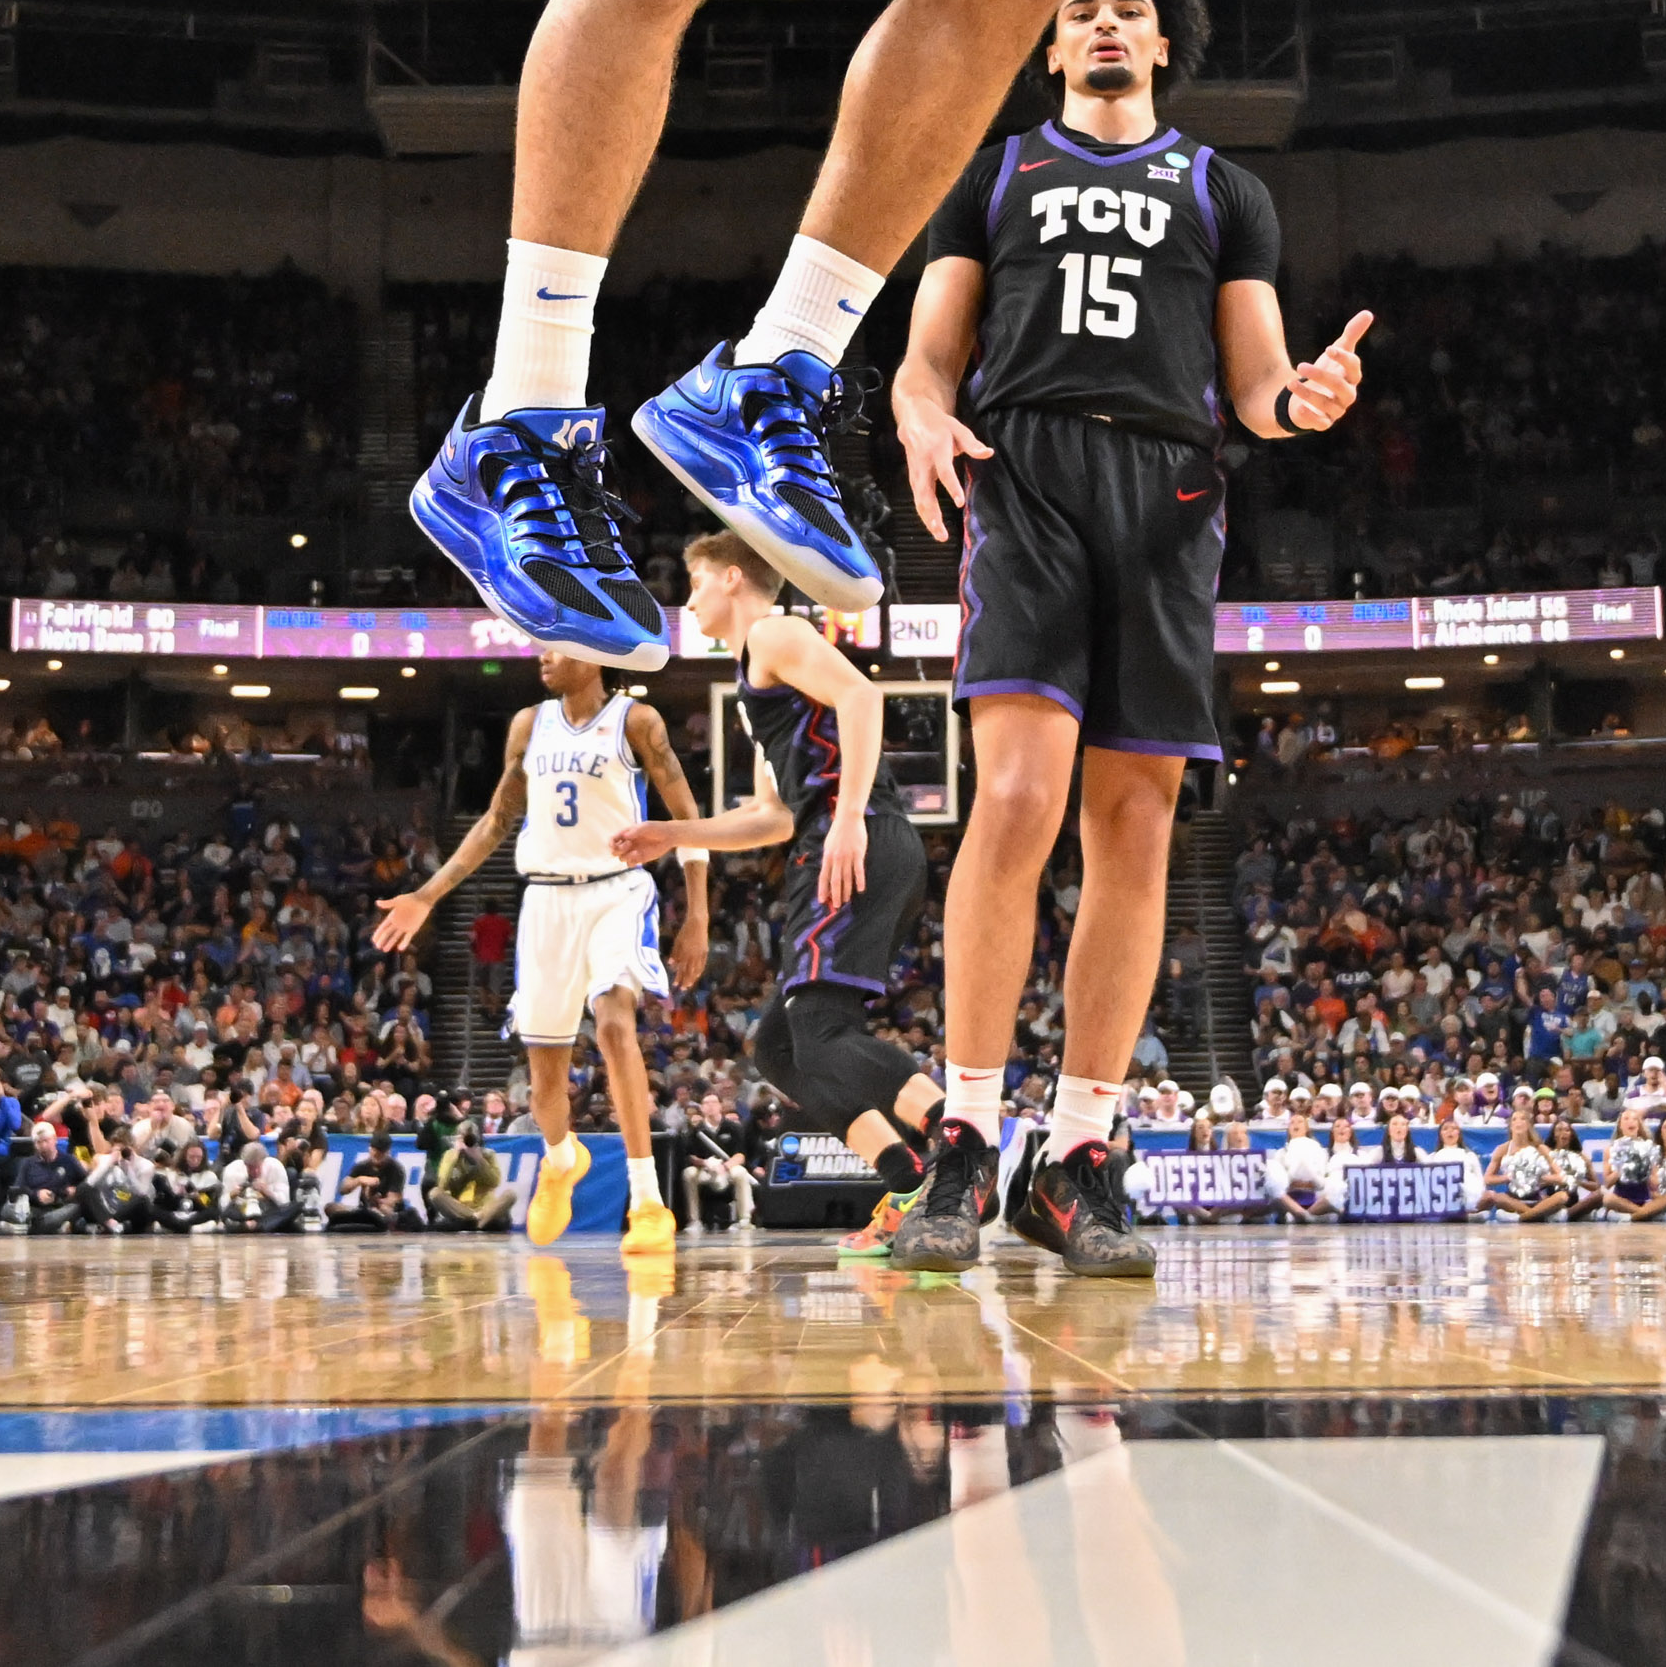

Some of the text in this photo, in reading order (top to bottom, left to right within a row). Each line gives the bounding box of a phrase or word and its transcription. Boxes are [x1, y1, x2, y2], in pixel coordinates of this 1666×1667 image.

[1031, 186, 1172, 248] TCU
[1057, 252, 1143, 339] 15
[40, 601, 134, 628] Fairfield
[1433, 598, 1484, 623] Rhode
[1486, 595, 1537, 621] Island
[1593, 603, 1633, 622] Final
[39, 625, 90, 651] Notre
[93, 626, 144, 653] Dame
[198, 618, 239, 638] Final
[1247, 625, 1323, 651] 2 0
[1434, 621, 1533, 647] Alabama
[351, 632, 425, 658] 0 3
[536, 751, 609, 780] DUKE
[555, 780, 579, 828] 3
[1146, 1153, 1264, 1204] DEFENSE
[1347, 1165, 1462, 1217] DEFENSE
